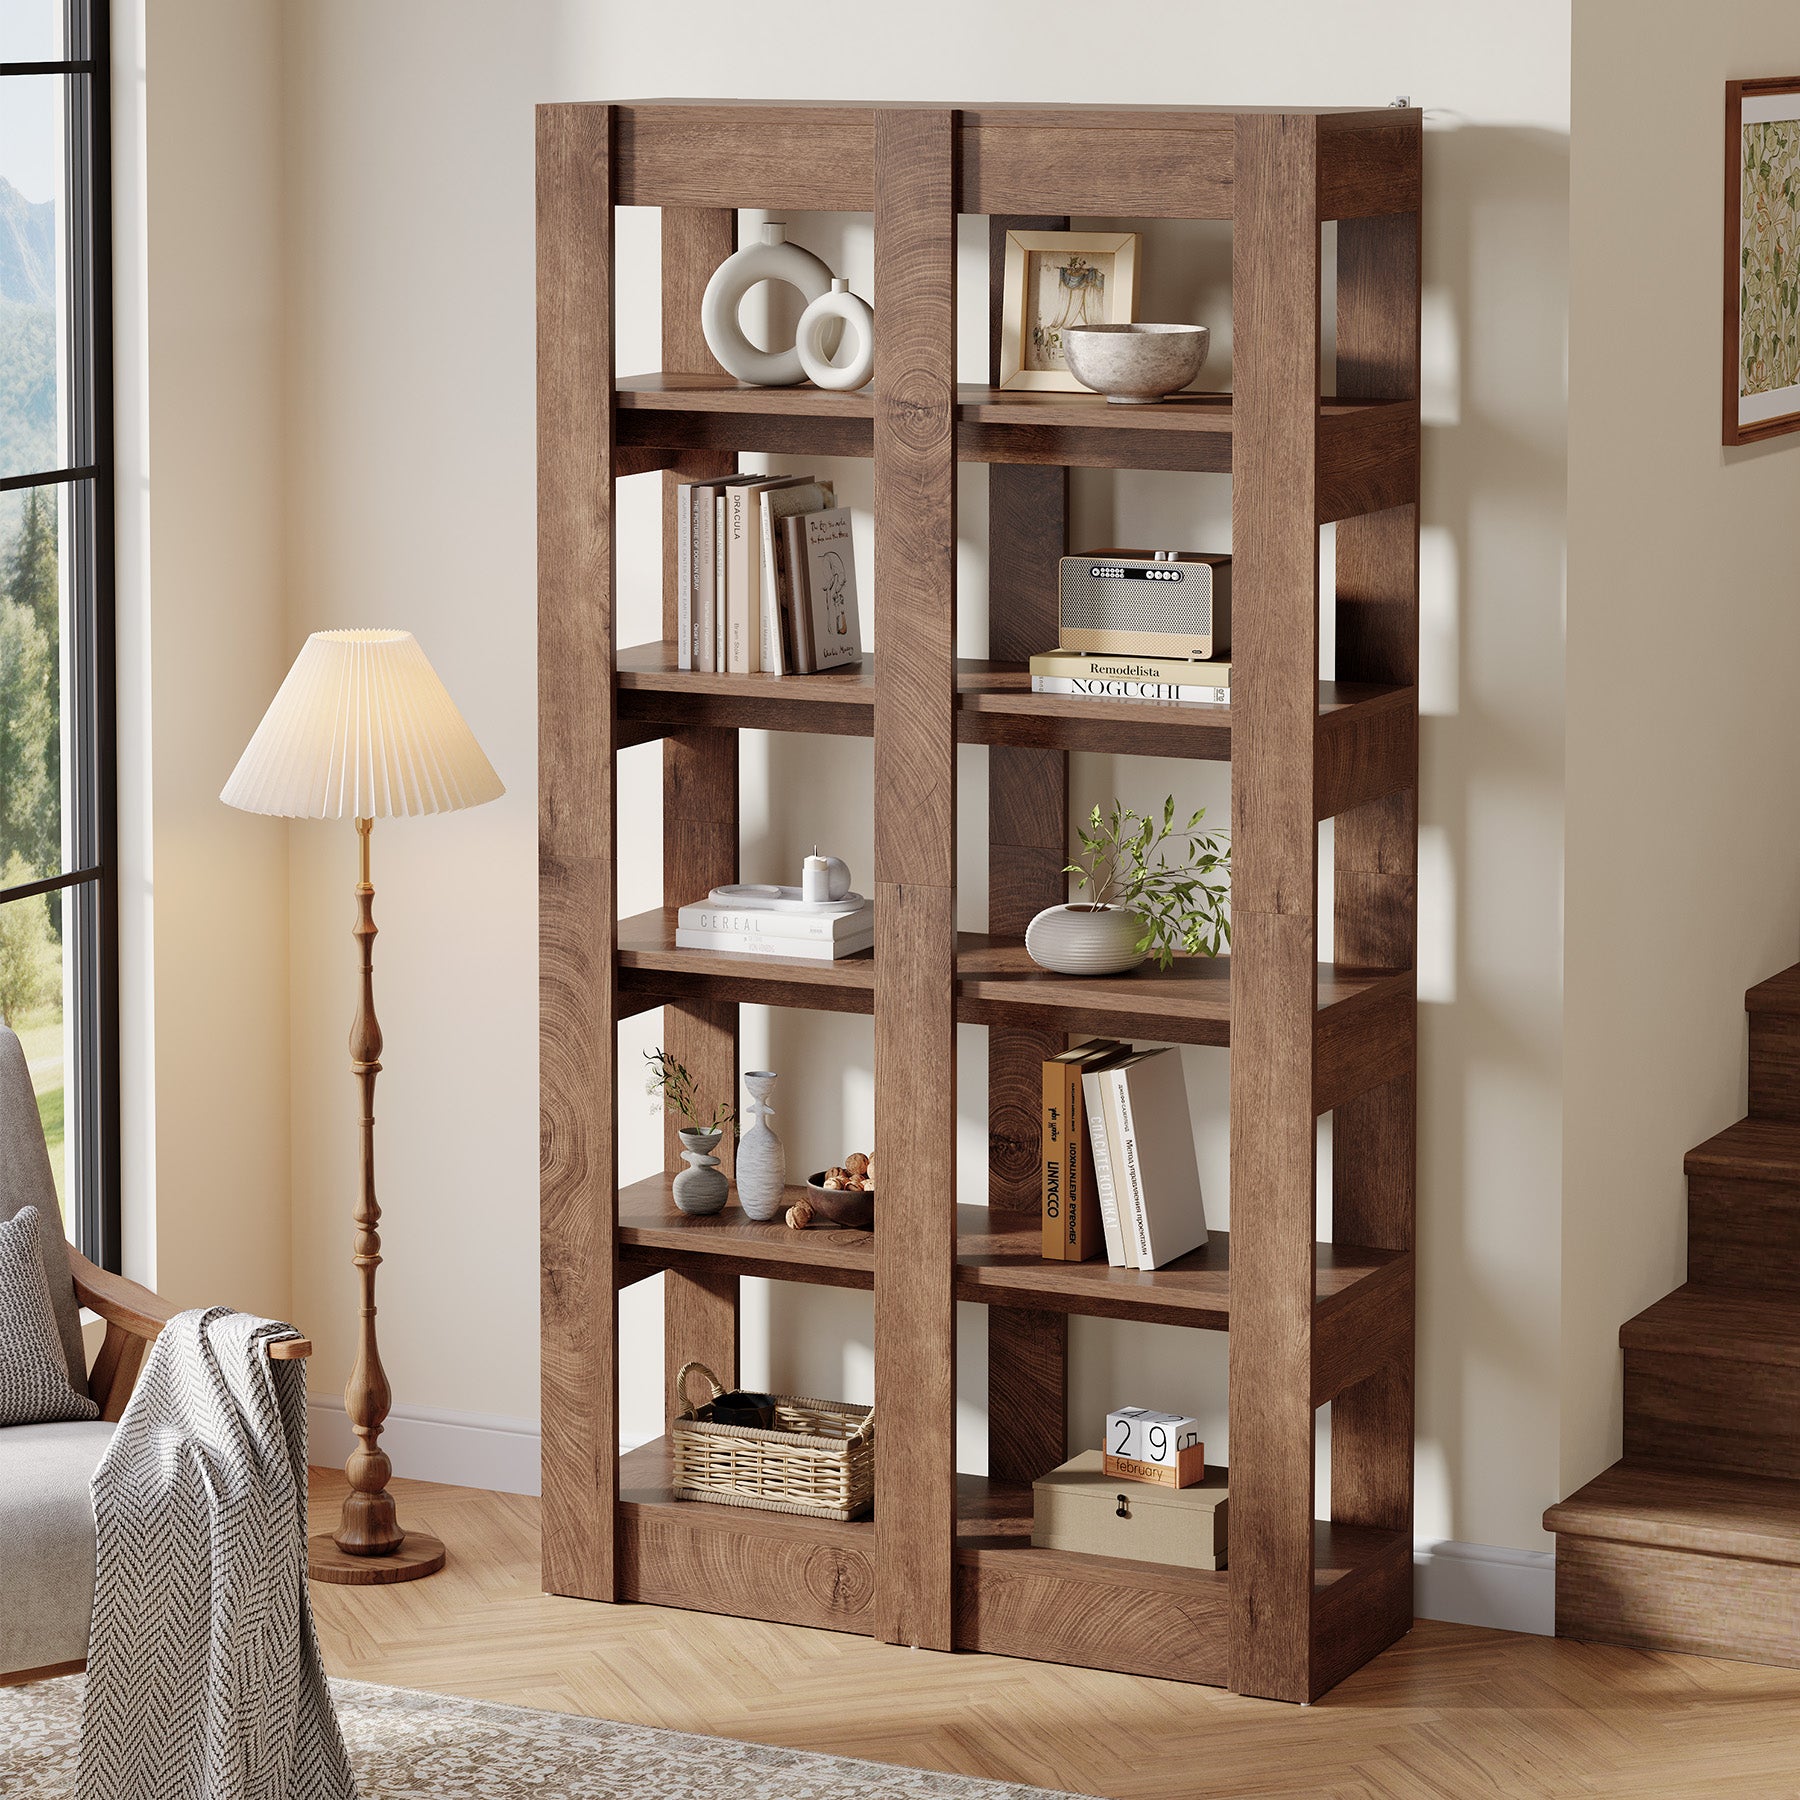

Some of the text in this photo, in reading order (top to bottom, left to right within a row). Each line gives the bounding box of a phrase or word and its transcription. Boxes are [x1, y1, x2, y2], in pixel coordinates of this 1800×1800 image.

[1090, 663, 1160, 678] Remodelista
[1071, 678, 1181, 700] NOGUCHI
[700, 914, 761, 932] CEREAL
[1091, 1116, 1118, 1229] СПАСИТЕ КОТИКА!
[1126, 1139, 1148, 1256] Метод управления проектами
[1116, 1458, 1164, 1481] february
